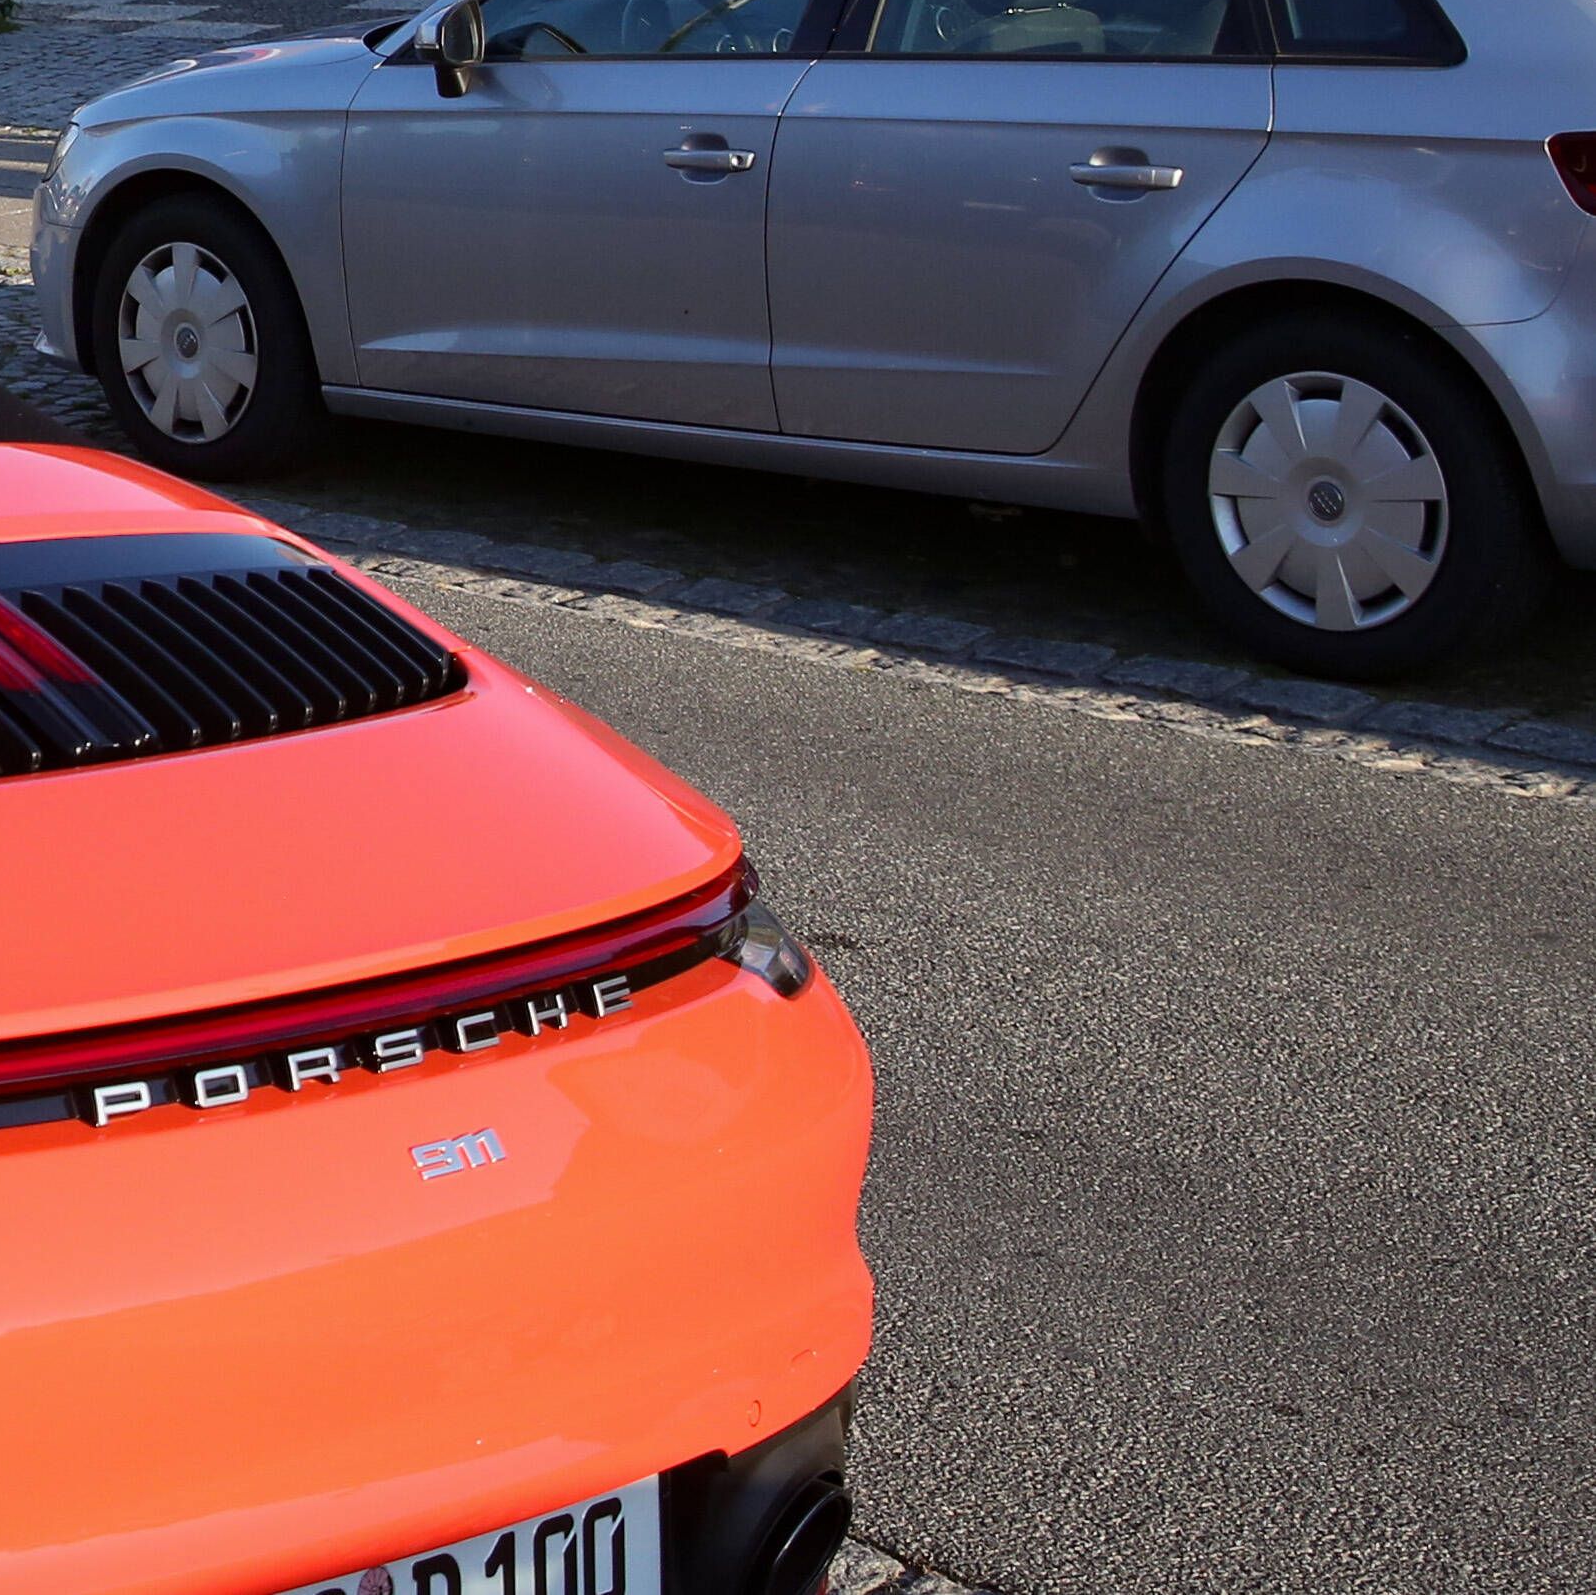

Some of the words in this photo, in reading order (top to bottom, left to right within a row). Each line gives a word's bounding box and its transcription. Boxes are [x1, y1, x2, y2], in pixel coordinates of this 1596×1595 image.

[94, 974, 633, 1127] PORSCHE
[410, 1128, 507, 1181] 911
[484, 1496, 625, 1595] 100
